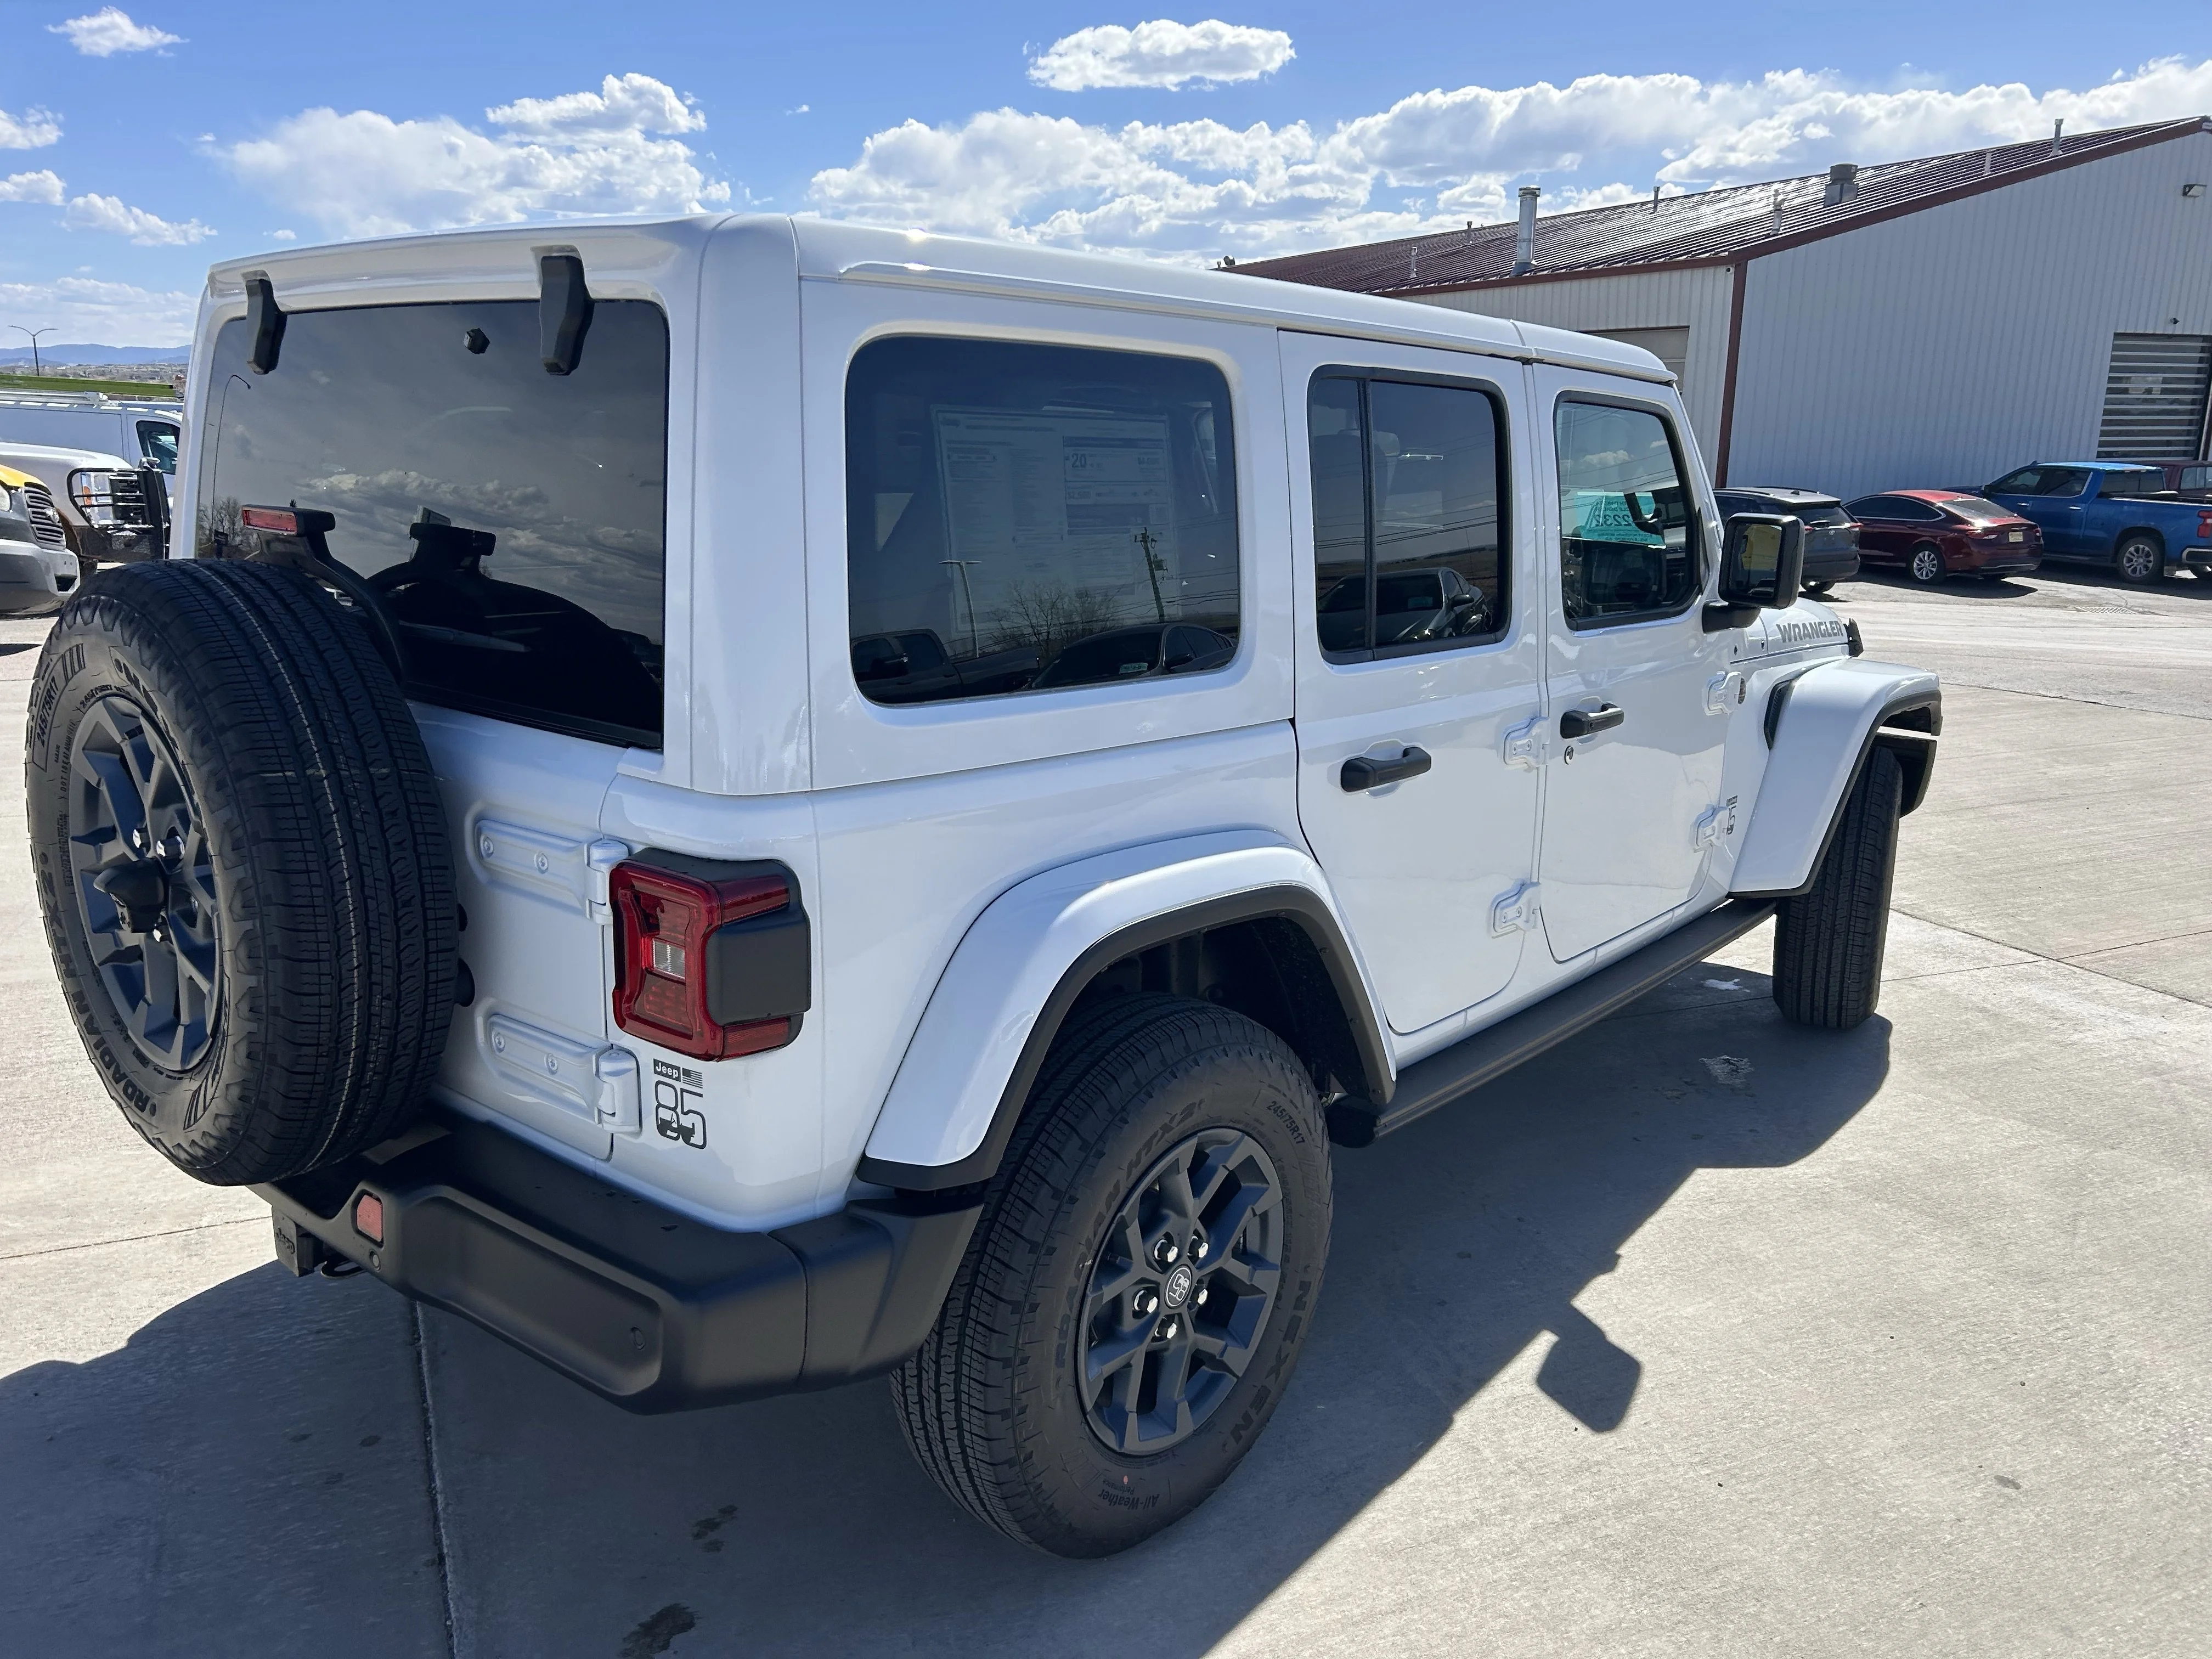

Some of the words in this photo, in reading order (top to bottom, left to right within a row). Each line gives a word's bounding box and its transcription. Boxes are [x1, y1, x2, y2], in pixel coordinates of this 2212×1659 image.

[1071, 453, 1087, 468] 20
[1776, 619, 1844, 642] WRANGLER
[37, 676, 59, 748] 245/75R17
[42, 871, 75, 979] HTX2
[71, 990, 150, 1114] ROADIAN
[656, 1062, 679, 1079] Jeep
[655, 1080, 707, 1149] 85
[1267, 1101, 1305, 1144] 245/75R17
[1056, 1181, 1120, 1368] ROADIAN
[1126, 1099, 1197, 1178] HTX2
[1232, 1281, 1312, 1445] NEXEN
[1098, 1488, 1160, 1510] All-Weather
